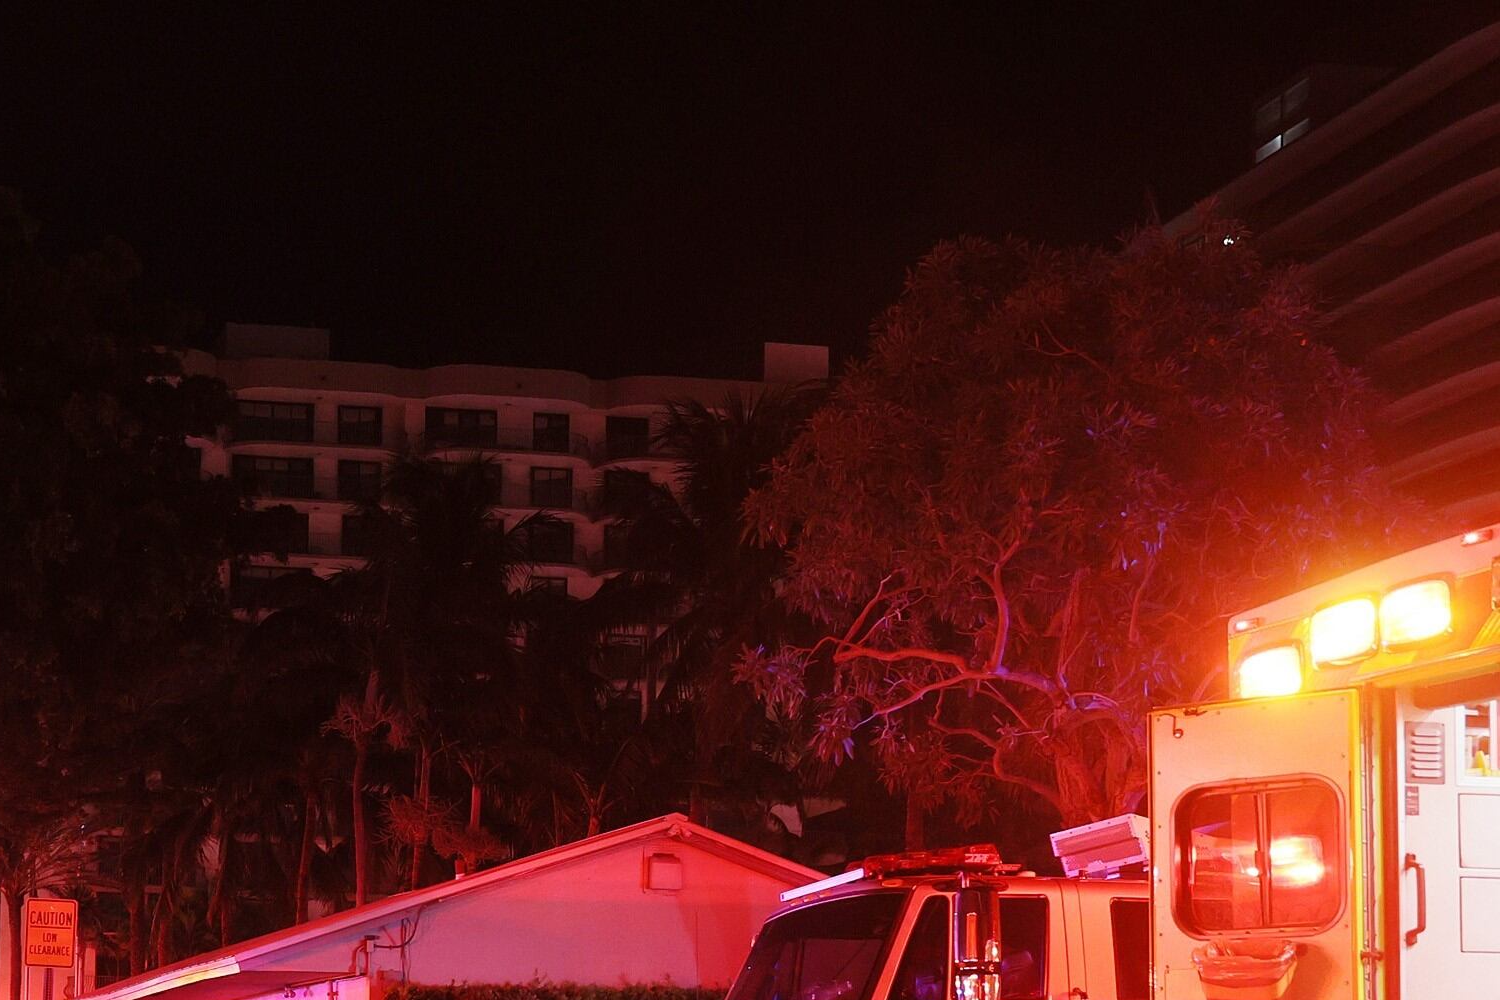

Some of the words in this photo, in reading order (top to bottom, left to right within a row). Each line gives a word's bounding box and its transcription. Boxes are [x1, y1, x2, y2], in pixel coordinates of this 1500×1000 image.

[30, 910, 73, 926] CAUTION
[42, 932, 58, 943] LOW
[29, 944, 70, 956] CLEARANCE
